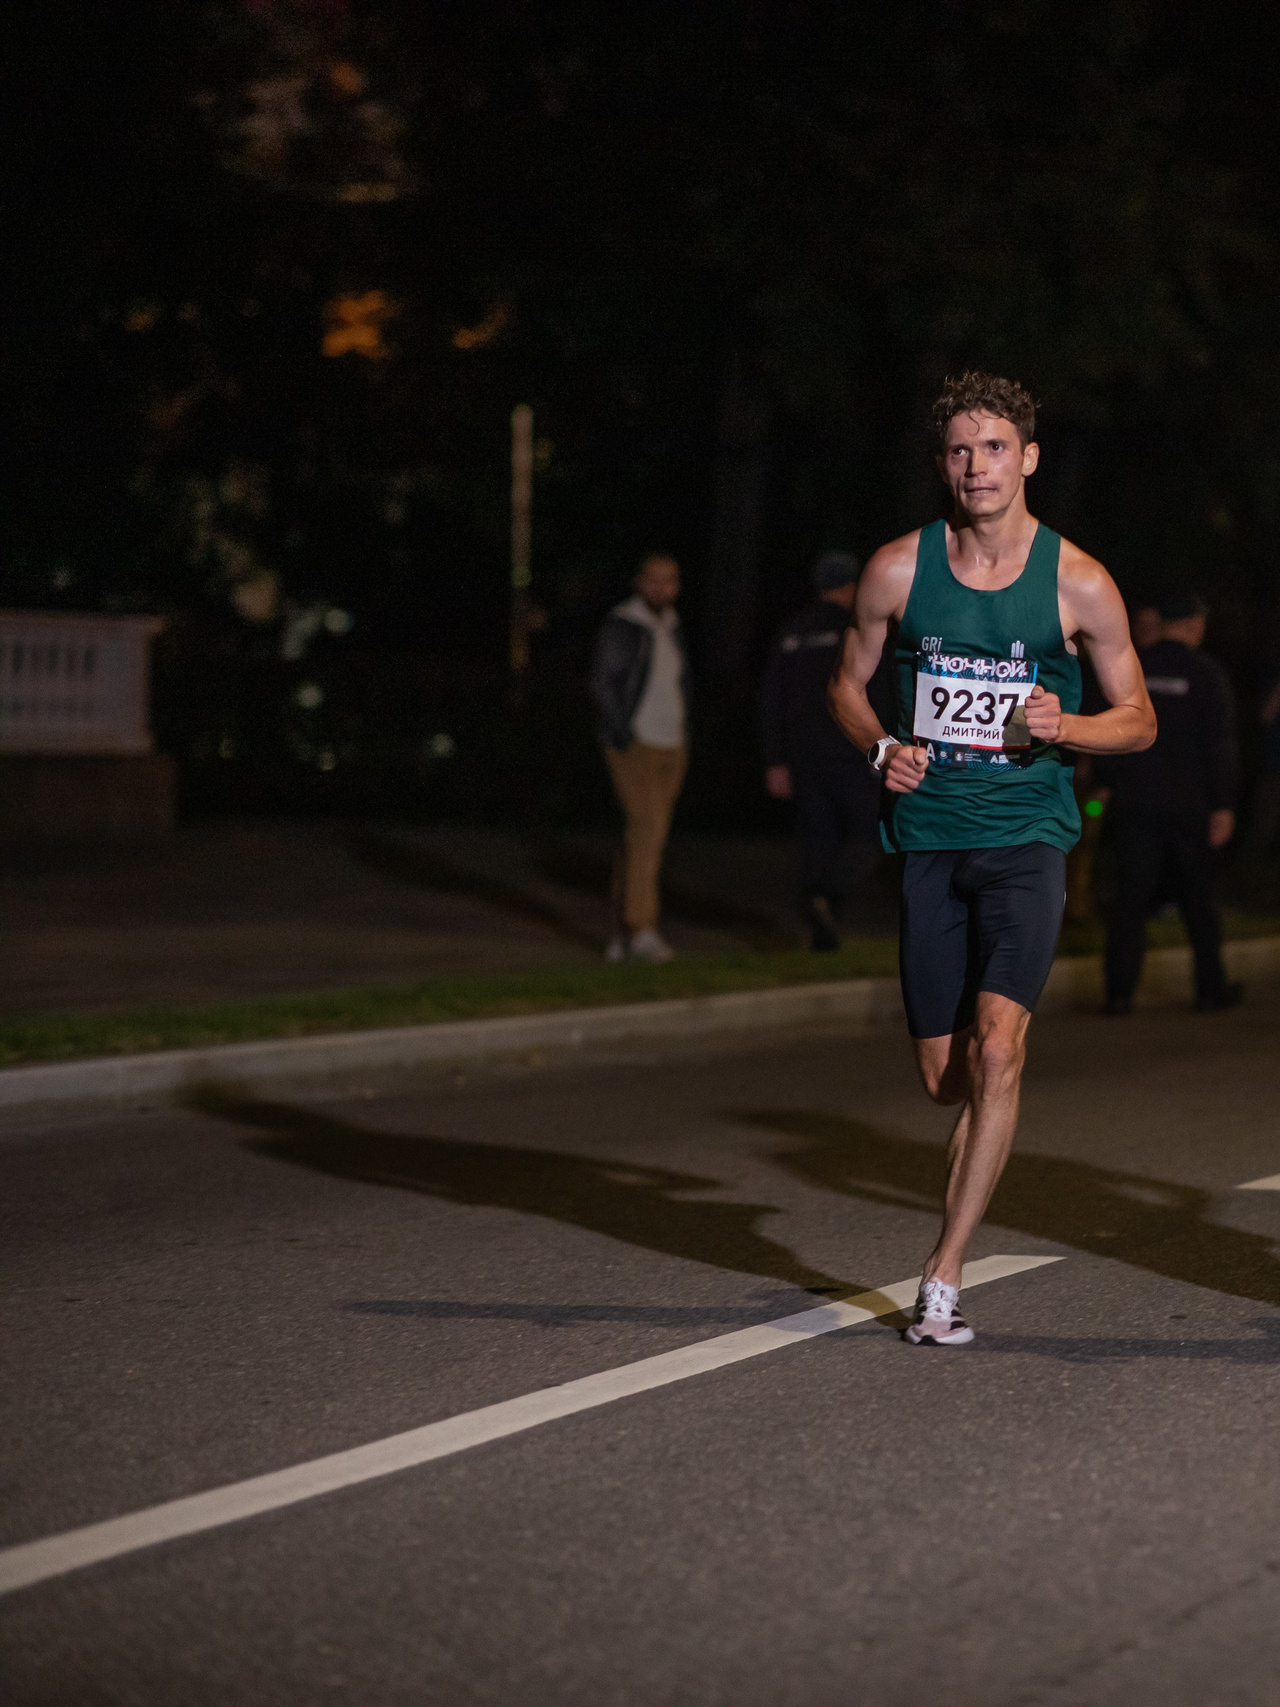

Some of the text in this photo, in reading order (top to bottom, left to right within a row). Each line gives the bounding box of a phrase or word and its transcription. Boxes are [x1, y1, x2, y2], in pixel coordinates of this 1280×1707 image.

[928, 652, 1028, 678] НОЧНОЙ
[931, 687, 1019, 727] 9237
[942, 726, 1000, 740] ДМИТРИЙ
